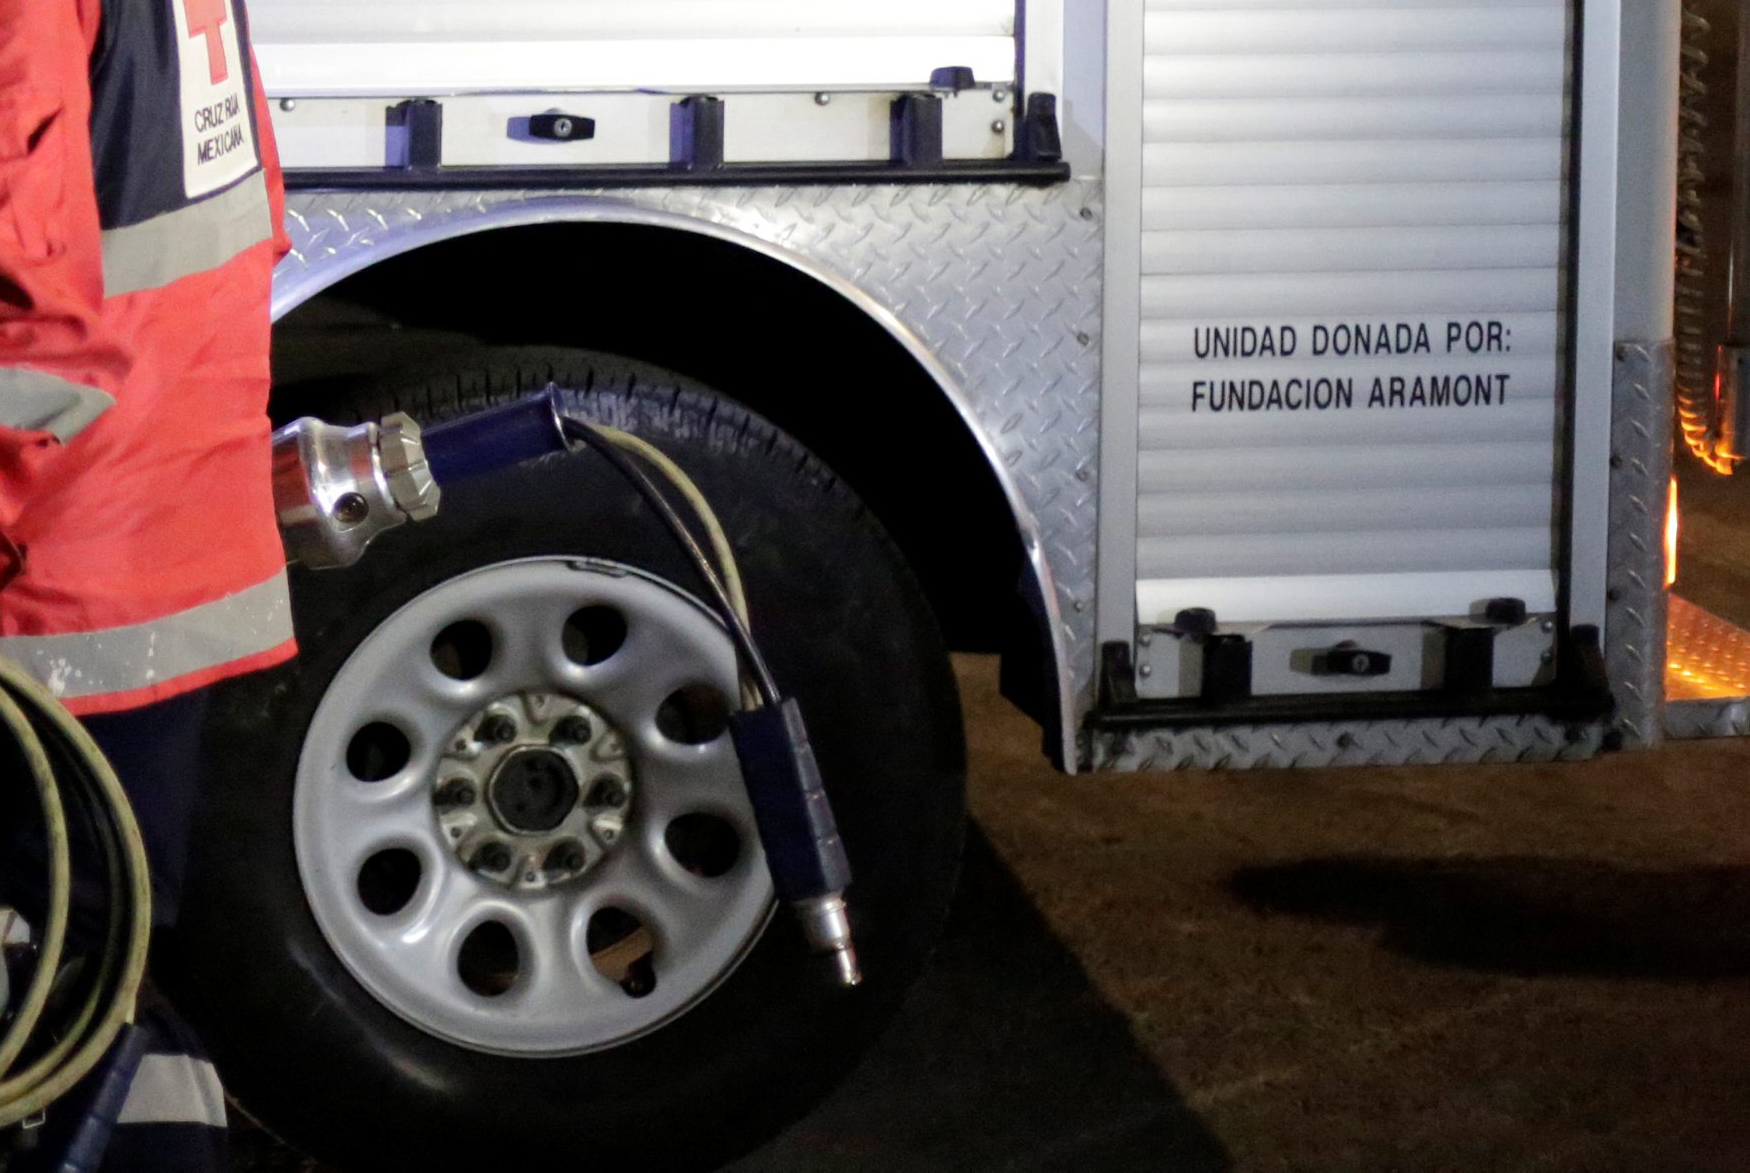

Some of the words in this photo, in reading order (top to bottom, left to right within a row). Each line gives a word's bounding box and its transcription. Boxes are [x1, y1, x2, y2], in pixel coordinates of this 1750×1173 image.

[194, 101, 224, 133] CRUZ
[197, 123, 245, 166] MEXICANA
[1193, 326, 1297, 359] UNIDAD
[1312, 322, 1432, 356] DONADA
[1446, 321, 1512, 354] POR:
[1191, 378, 1353, 413] FUNDACION
[1367, 373, 1511, 409] ARAMONT
